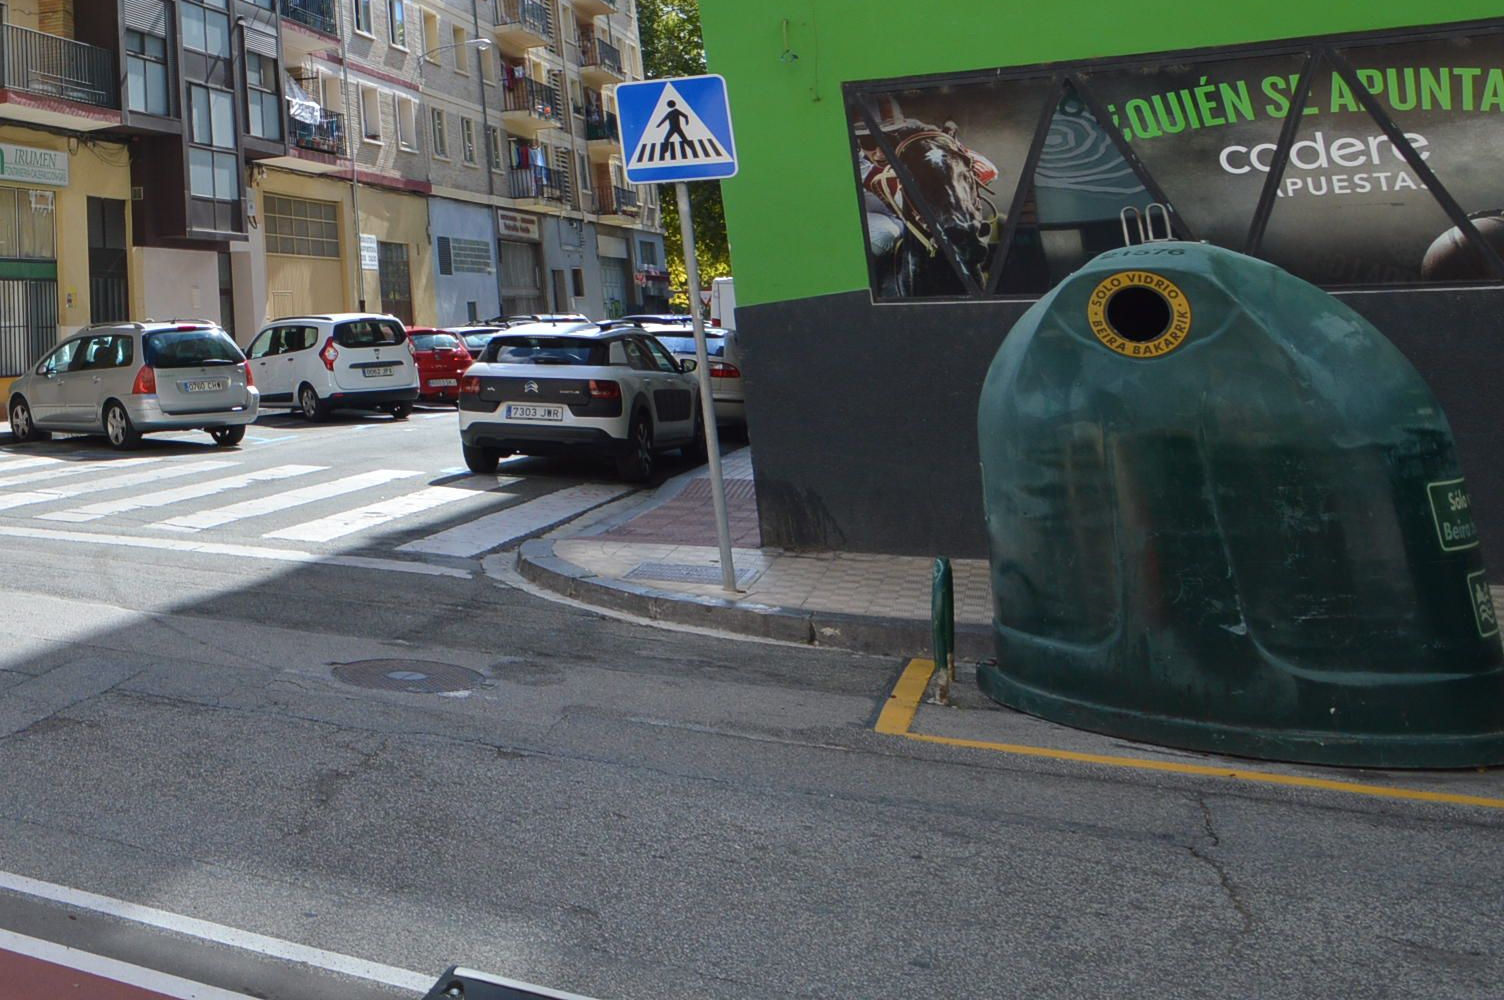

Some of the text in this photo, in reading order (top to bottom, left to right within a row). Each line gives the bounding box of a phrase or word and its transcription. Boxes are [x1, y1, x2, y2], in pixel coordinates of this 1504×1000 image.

[14, 148, 57, 169] IRUMEN
[1091, 274, 1179, 308] SOLO VIDRIO
[1093, 310, 1188, 355] BEIRA BAKARRIK
[512, 407, 559, 418] 7303 JWR
